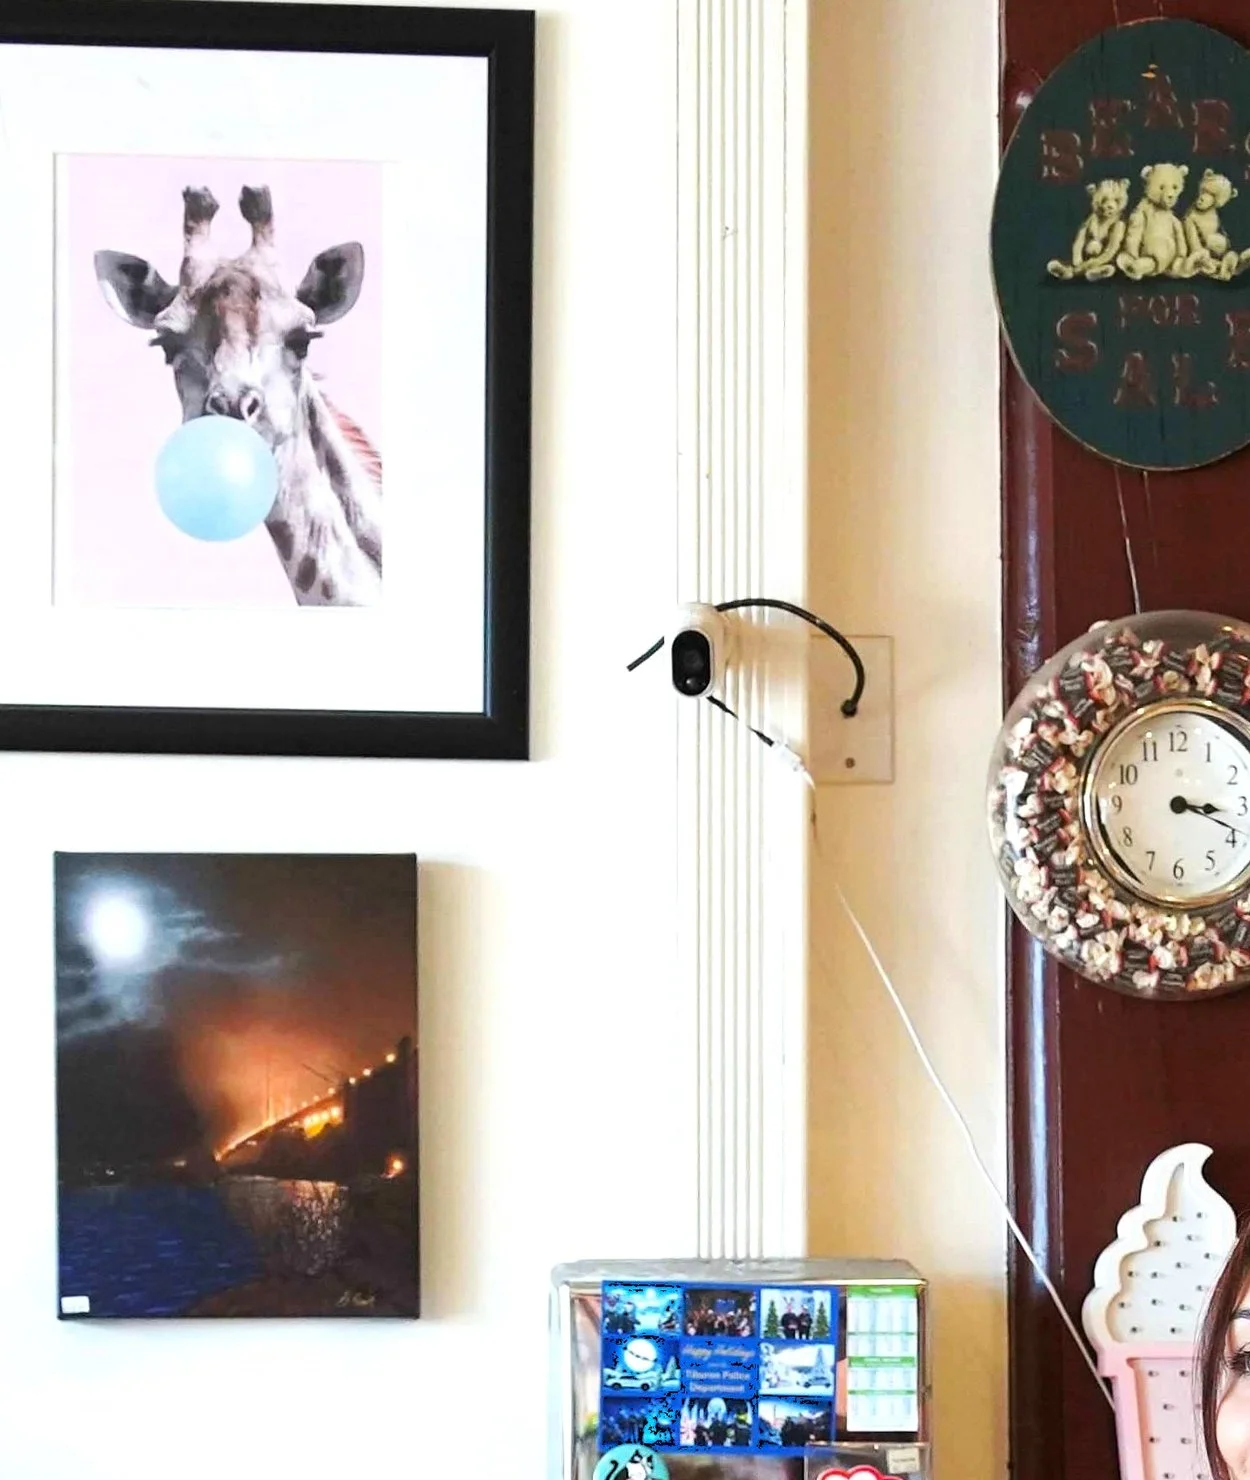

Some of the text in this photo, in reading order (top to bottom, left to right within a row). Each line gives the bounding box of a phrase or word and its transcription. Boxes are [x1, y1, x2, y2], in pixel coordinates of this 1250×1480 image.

[1119, 295, 1200, 327] FOR
[1142, 741, 1158, 762] 11
[1169, 731, 1188, 752] 12
[1205, 742, 1212, 763] 1
[1119, 764, 1138, 785] 10
[1227, 765, 1238, 785] 2
[1111, 795, 1122, 814] 9
[1237, 796, 1248, 816] 3
[1122, 827, 1133, 847] 8
[1225, 828, 1238, 848] 4
[1146, 851, 1155, 871] 7
[1173, 858, 1184, 880] 6
[1205, 851, 1216, 871] 5
